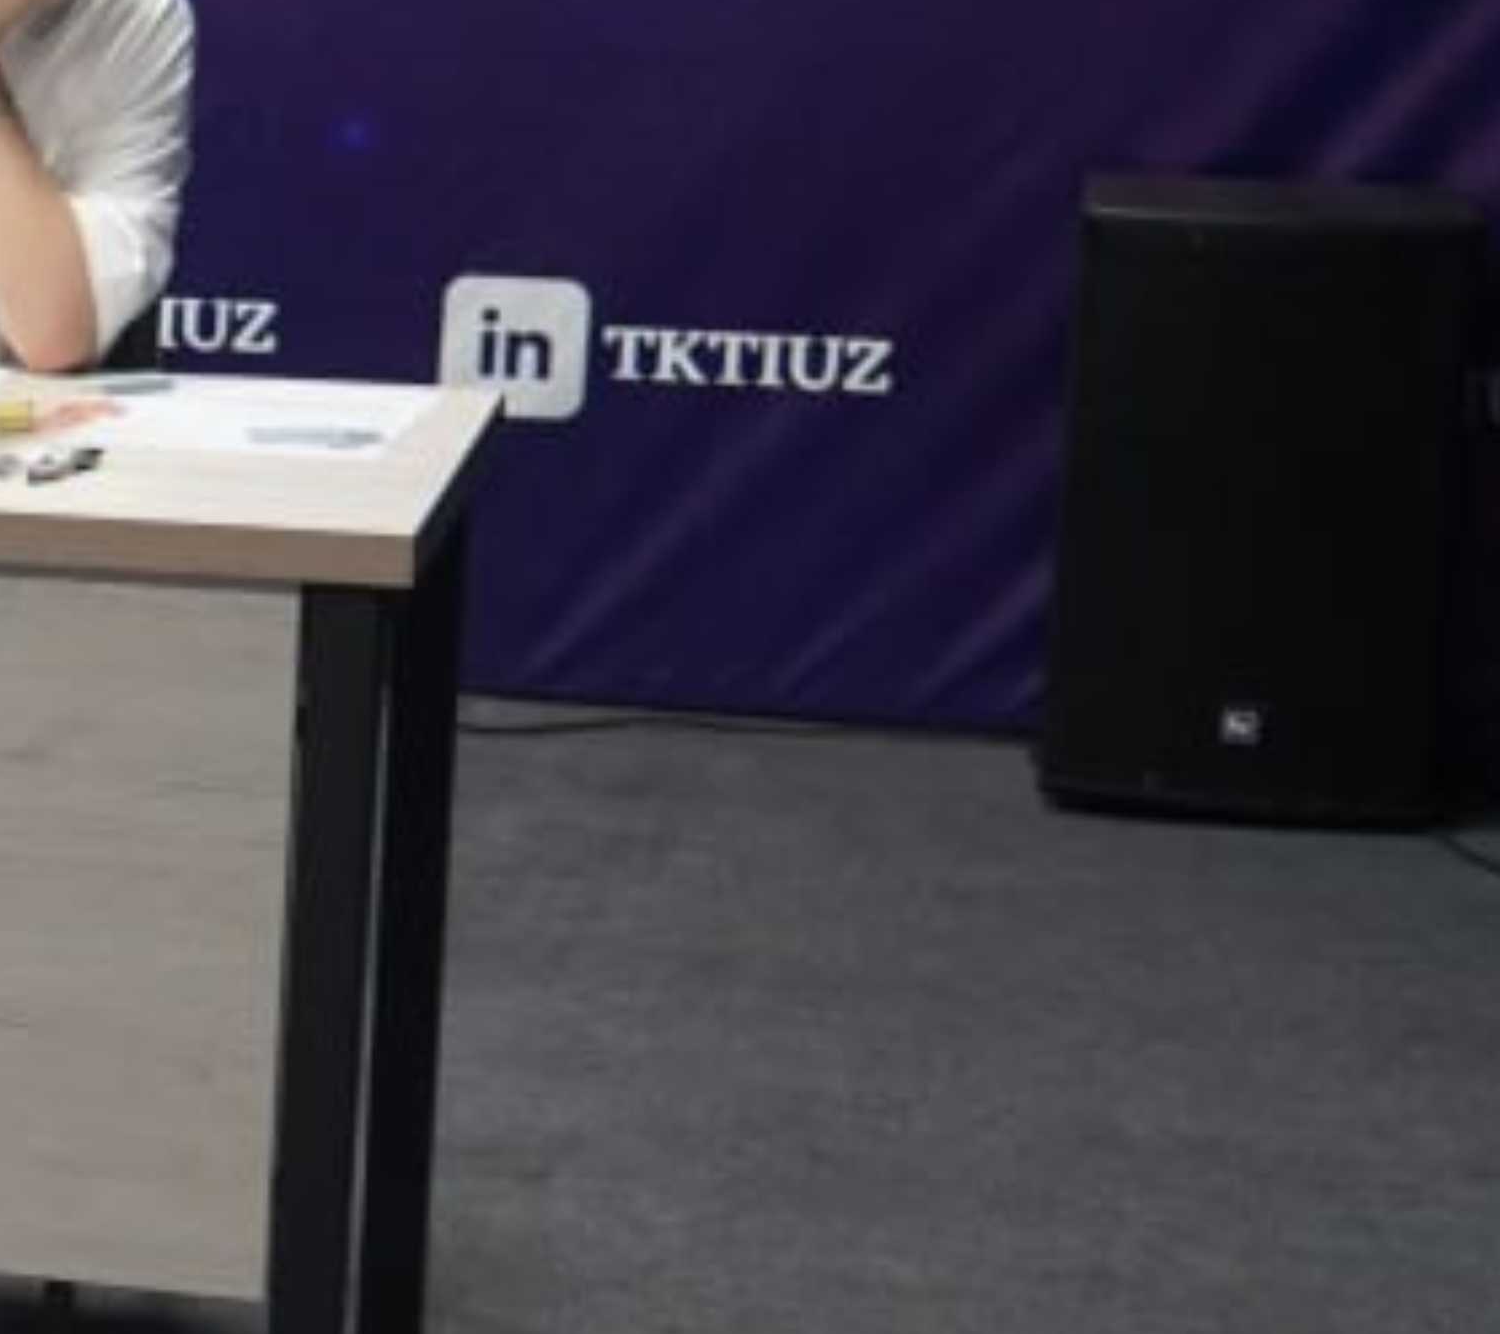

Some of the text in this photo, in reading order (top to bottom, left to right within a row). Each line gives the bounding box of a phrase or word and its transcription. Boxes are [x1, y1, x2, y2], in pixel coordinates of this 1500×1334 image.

[157, 296, 278, 354] IUZ
[480, 307, 894, 393] in TKTIUZ
